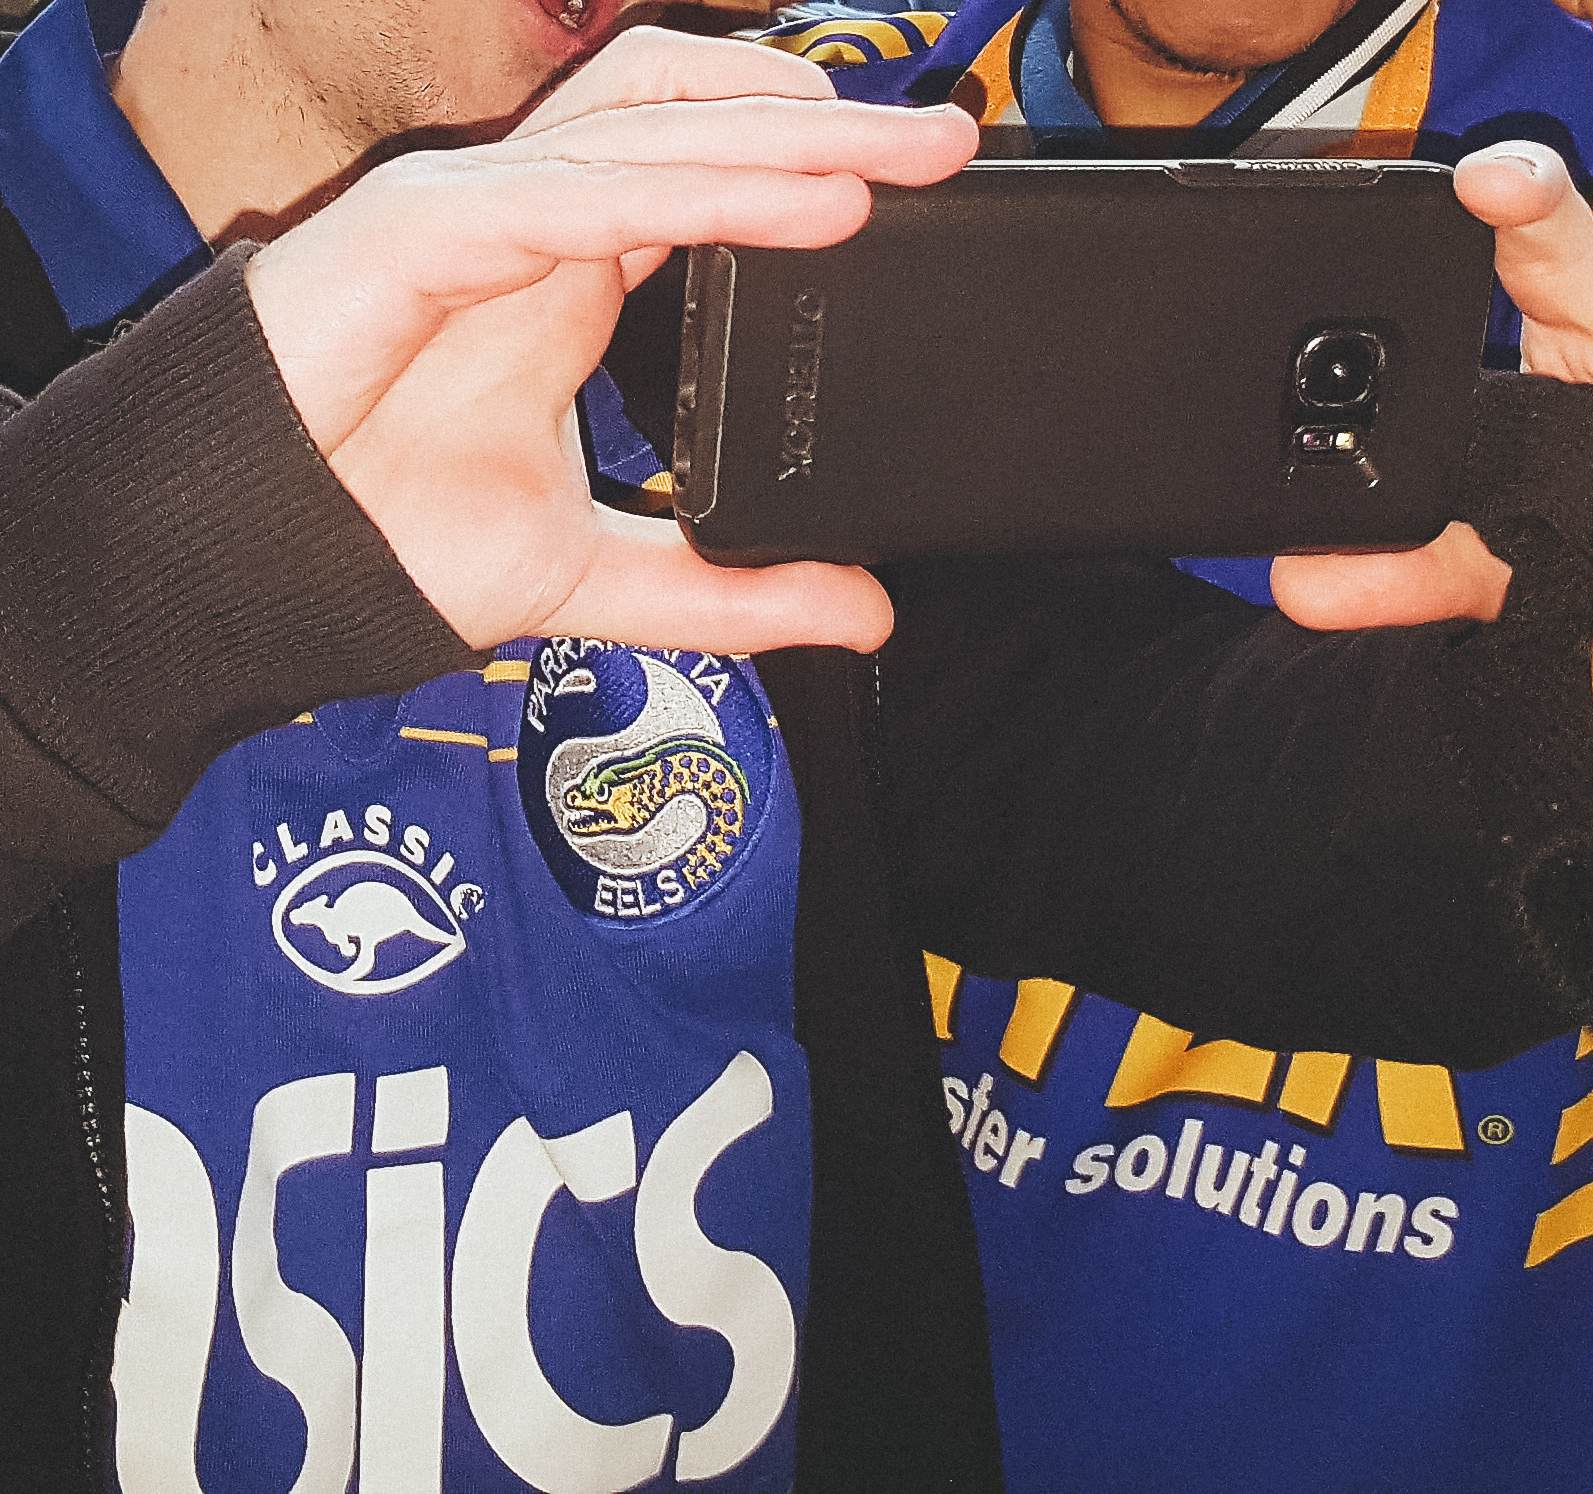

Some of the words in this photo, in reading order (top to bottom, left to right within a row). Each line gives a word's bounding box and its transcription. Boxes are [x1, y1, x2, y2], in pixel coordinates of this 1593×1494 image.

[252, 804, 485, 921] CLASSIC
[594, 869, 684, 919] EELS
[1064, 1118, 1460, 1259] solutions
